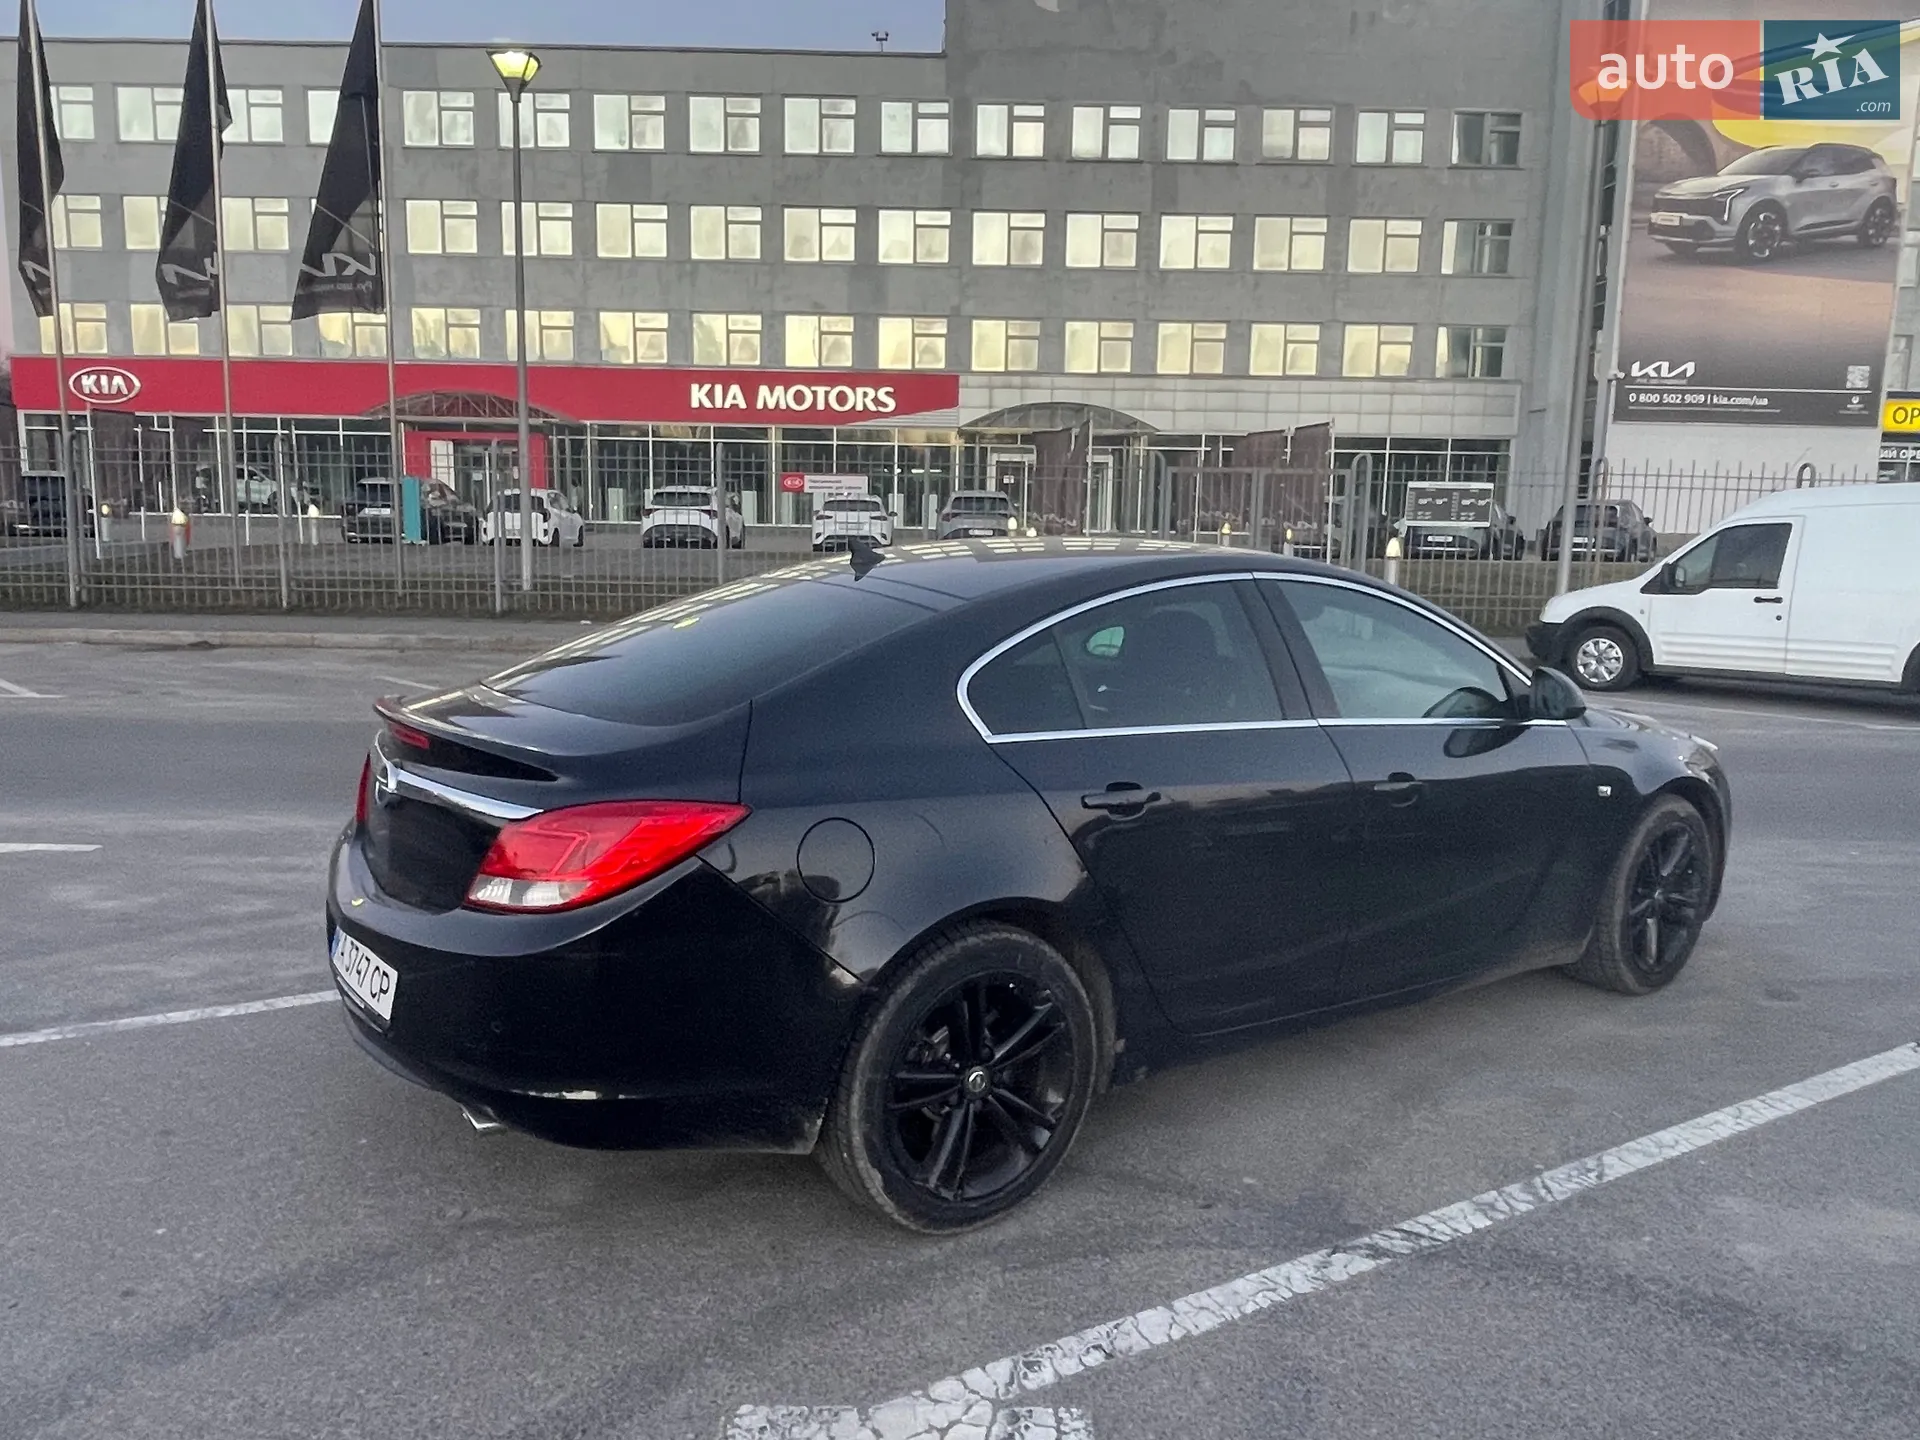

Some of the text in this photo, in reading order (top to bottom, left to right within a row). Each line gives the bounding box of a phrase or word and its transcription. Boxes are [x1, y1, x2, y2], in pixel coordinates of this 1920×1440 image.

[1631, 360, 1696, 378] KIA
[81, 374, 129, 395] KIA
[690, 383, 896, 412] KIA MOTORS
[1629, 393, 1637, 402] 0
[1640, 393, 1660, 403] 800
[1662, 393, 1682, 404] 502
[1684, 394, 1705, 404] 909
[1713, 394, 1769, 406] kia.com/ua
[370, 965, 390, 1004] CP
